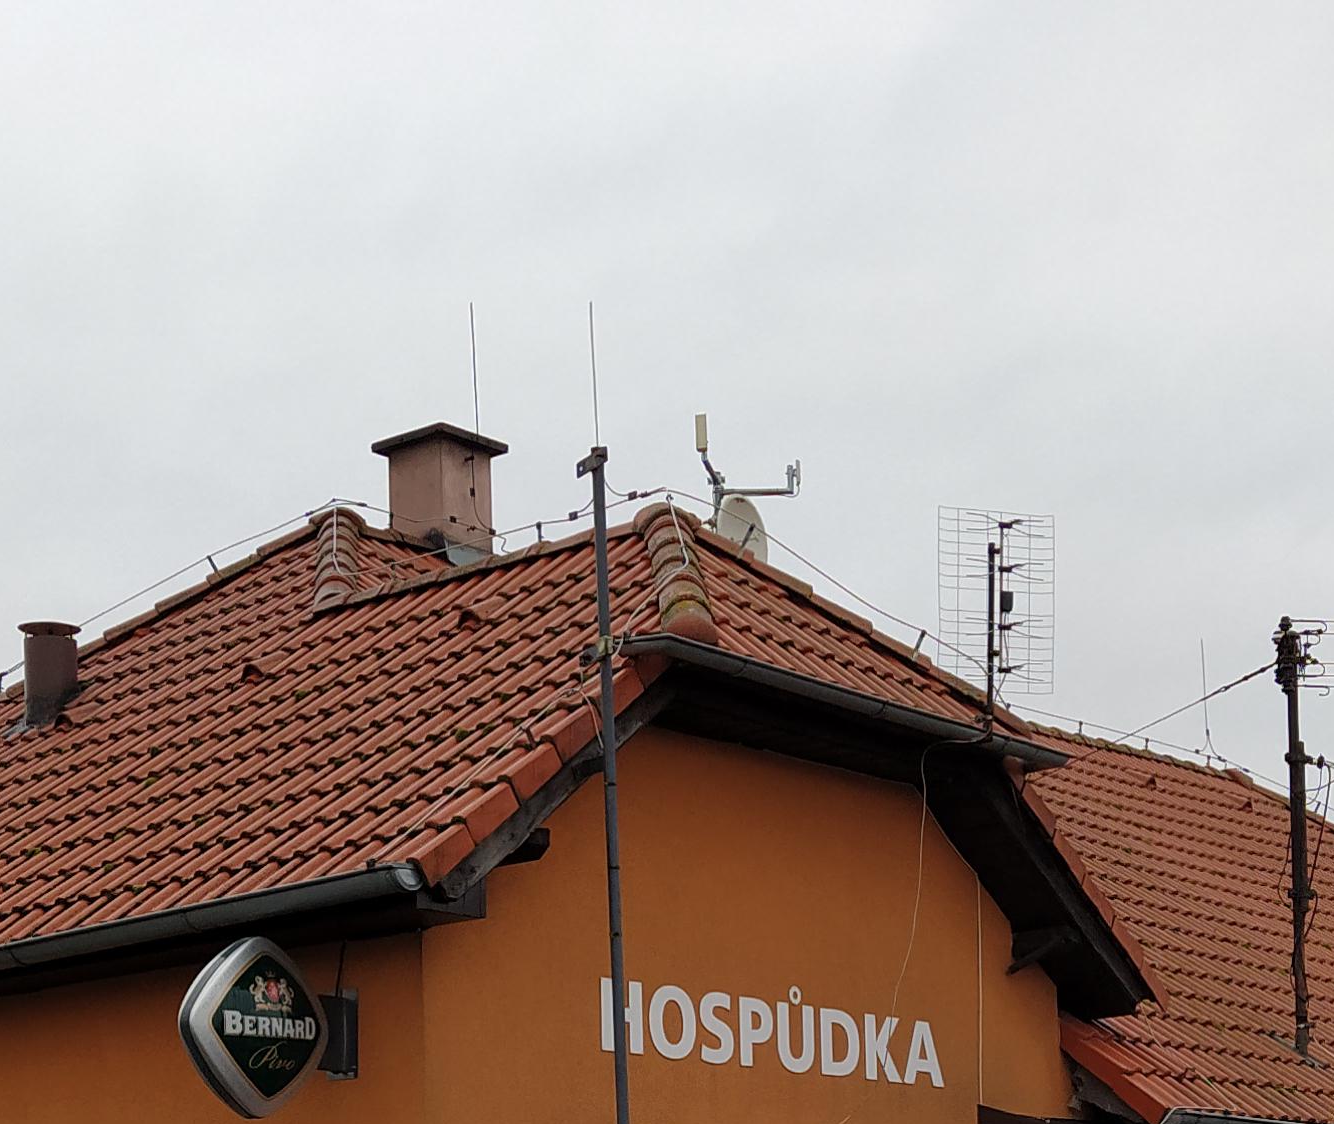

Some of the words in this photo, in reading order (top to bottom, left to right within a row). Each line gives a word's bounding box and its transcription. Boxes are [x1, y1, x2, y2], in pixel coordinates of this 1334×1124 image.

[223, 1009, 316, 1041] BERNARD
[600, 976, 945, 1089] HOSPŮDKA
[249, 1041, 297, 1071] Pivo
